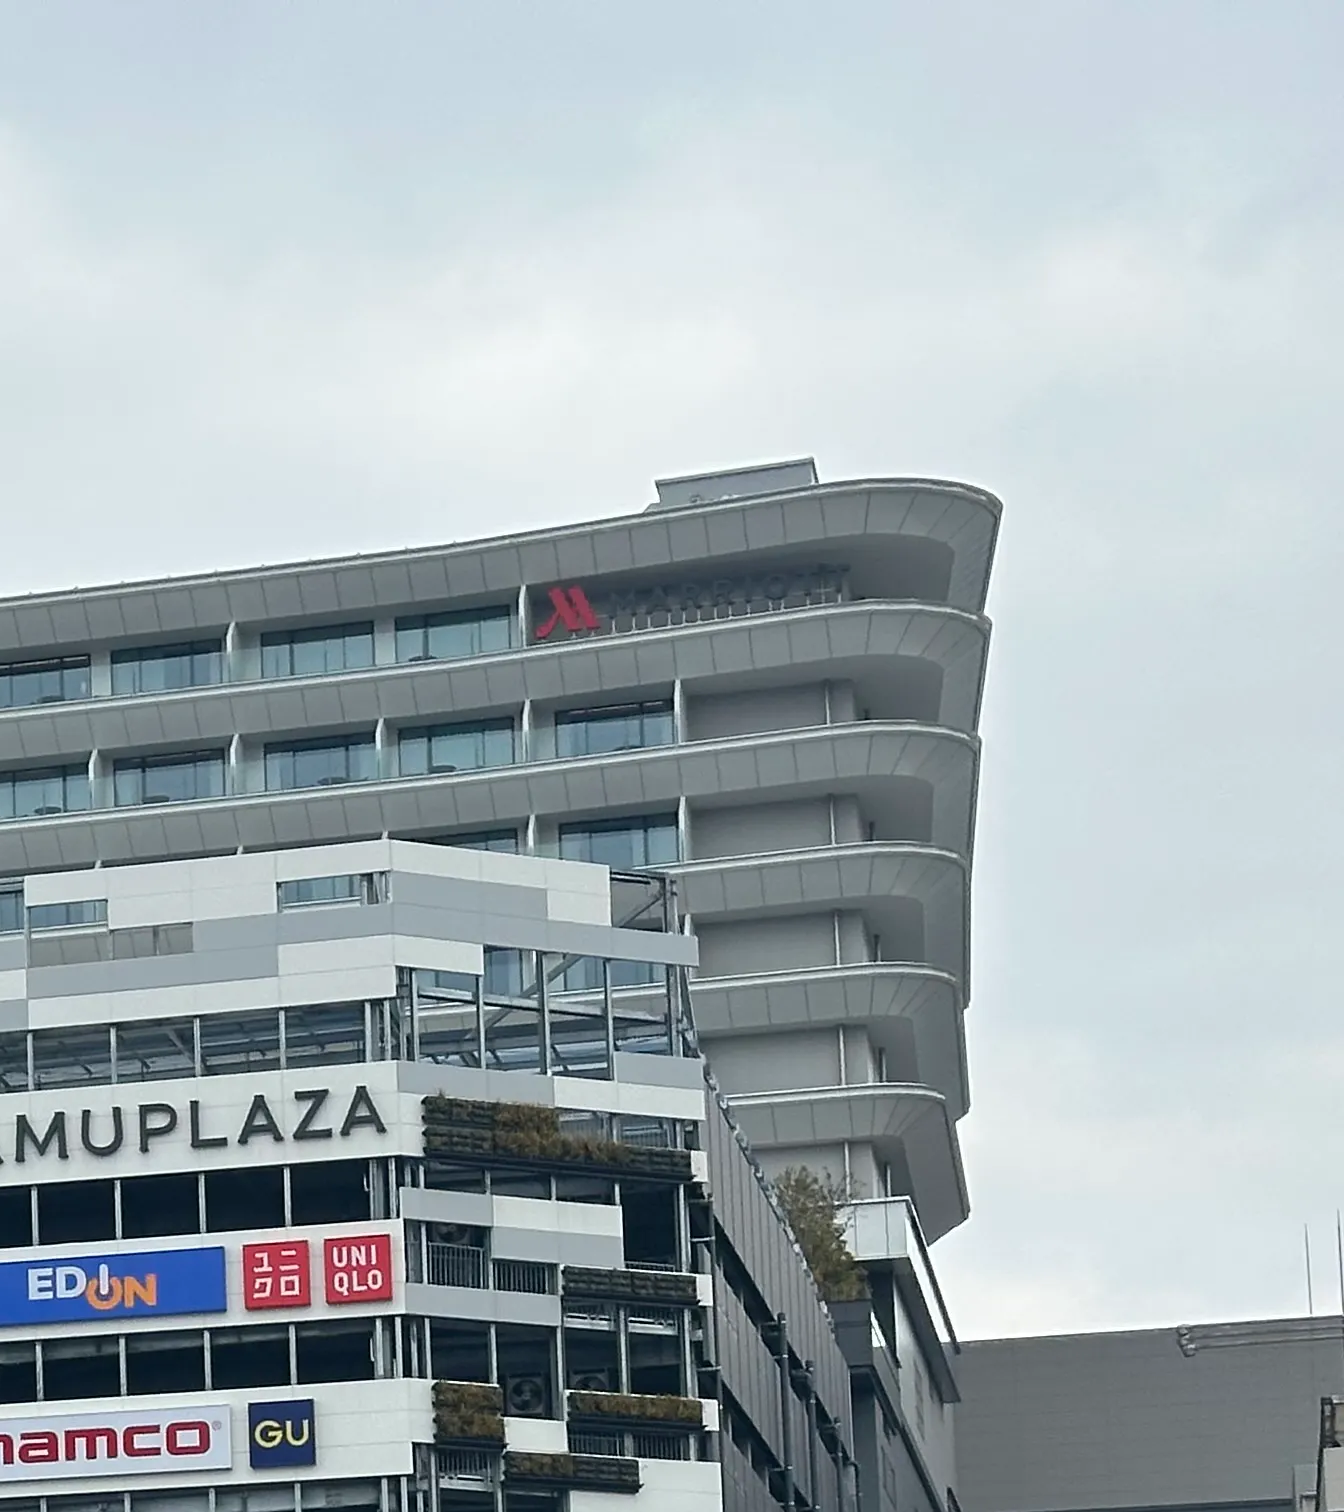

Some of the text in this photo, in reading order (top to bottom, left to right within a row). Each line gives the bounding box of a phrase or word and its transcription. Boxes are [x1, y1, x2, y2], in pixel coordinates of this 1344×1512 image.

[332, 1244, 378, 1268] UNI
[27, 1263, 157, 1310] EDION
[333, 1269, 383, 1297] QLO
[254, 1419, 310, 1449] GU
